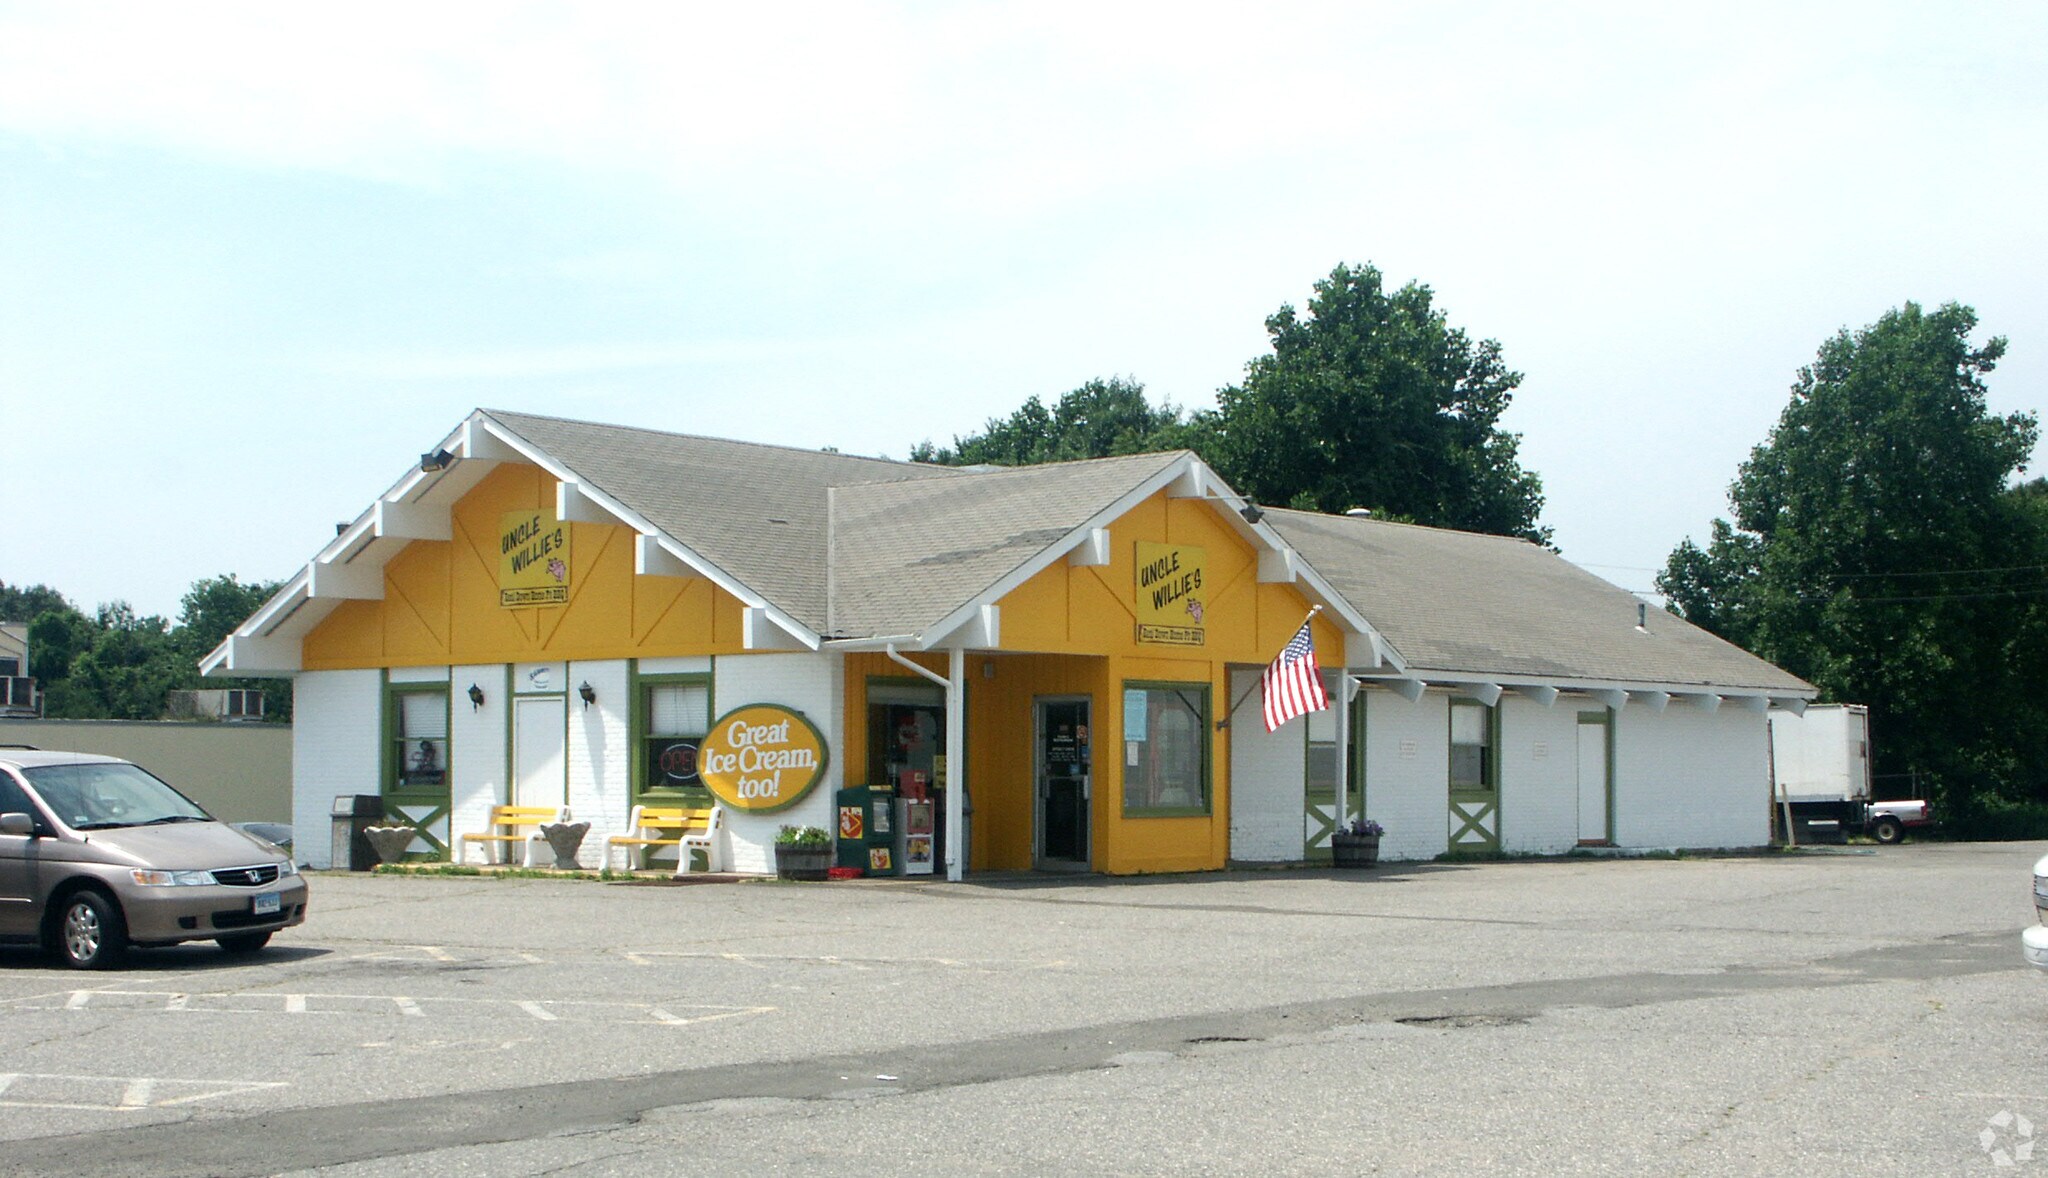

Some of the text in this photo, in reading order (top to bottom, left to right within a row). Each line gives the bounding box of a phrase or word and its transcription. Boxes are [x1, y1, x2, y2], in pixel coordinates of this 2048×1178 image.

[502, 515, 540, 555] UNCLE
[512, 528, 563, 574] WILLIE'S
[1141, 551, 1180, 588] UNCLE
[1152, 568, 1202, 611] WILLIE'S
[727, 718, 790, 748] Great
[704, 746, 818, 775] Ice Cream,
[736, 769, 781, 799] too!
